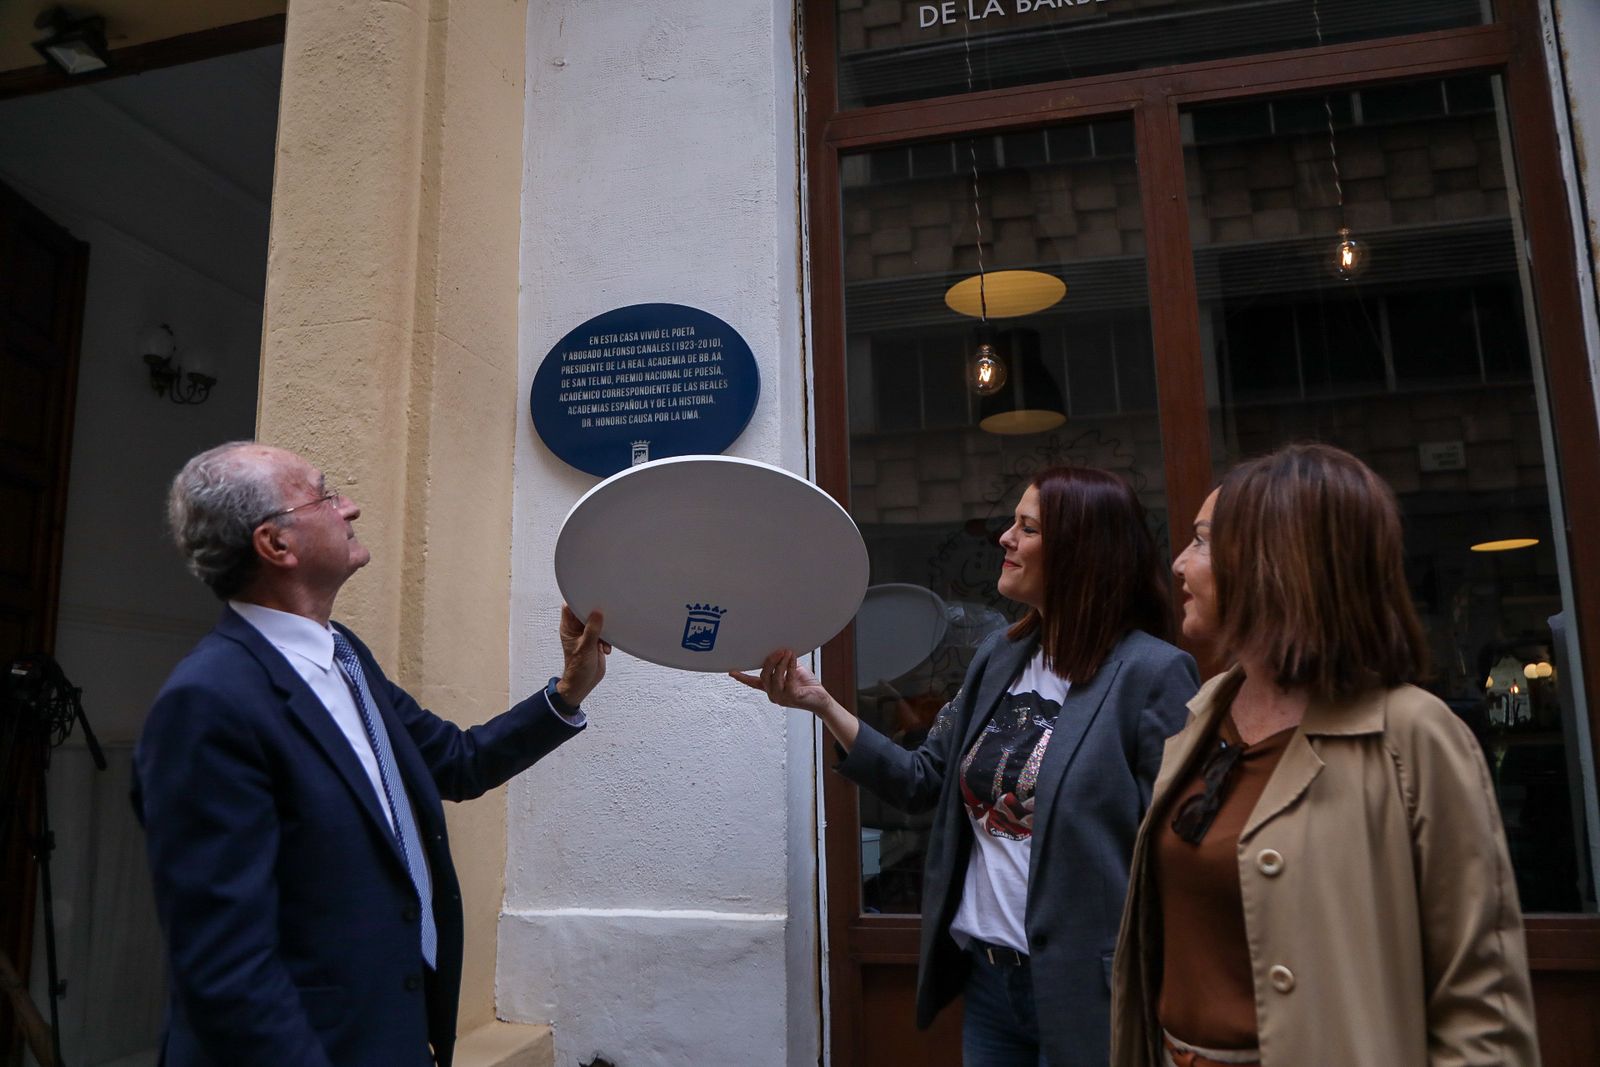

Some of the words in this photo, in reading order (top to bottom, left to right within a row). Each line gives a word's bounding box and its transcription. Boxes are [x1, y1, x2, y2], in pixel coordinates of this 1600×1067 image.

[919, 1, 957, 28] DE
[968, 0, 1005, 20] LA
[590, 336, 598, 345] EN
[600, 334, 617, 344] ESTA
[620, 332, 638, 342] CASA
[640, 328, 659, 340] VIVIÓ
[661, 329, 670, 338] EL
[672, 326, 694, 337] POETA
[569, 350, 602, 360] ABOGADO
[603, 346, 636, 357] ALFONSO
[636, 343, 670, 354] CANALES
[561, 362, 604, 375] PRESIDENTE
[606, 361, 615, 370] DE
[617, 360, 626, 369] LA
[628, 358, 645, 368] REAL
[648, 355, 686, 367] ACADEMIA
[688, 354, 697, 363] DE
[561, 379, 570, 388] DE
[572, 377, 586, 388] SAN
[588, 375, 614, 386] TELMO,
[615, 372, 643, 383] PREMIO
[645, 369, 681, 380] NACIONAL
[683, 368, 693, 378] DE
[559, 389, 600, 402] ACADÉMICO
[602, 384, 670, 399] CORRESPONDIENTE
[672, 383, 682, 393] DE
[684, 382, 698, 392] LAS
[700, 379, 728, 390] REALES
[568, 403, 609, 415] ACADEMIAS
[611, 399, 649, 412] ESPAÑOLA
[656, 398, 666, 408] DE
[668, 397, 677, 407] LA
[582, 418, 594, 428] DR.
[595, 416, 627, 426] HONORIS
[628, 413, 653, 424] CAUSA
[654, 412, 669, 422] POR
[671, 411, 680, 421] LA
